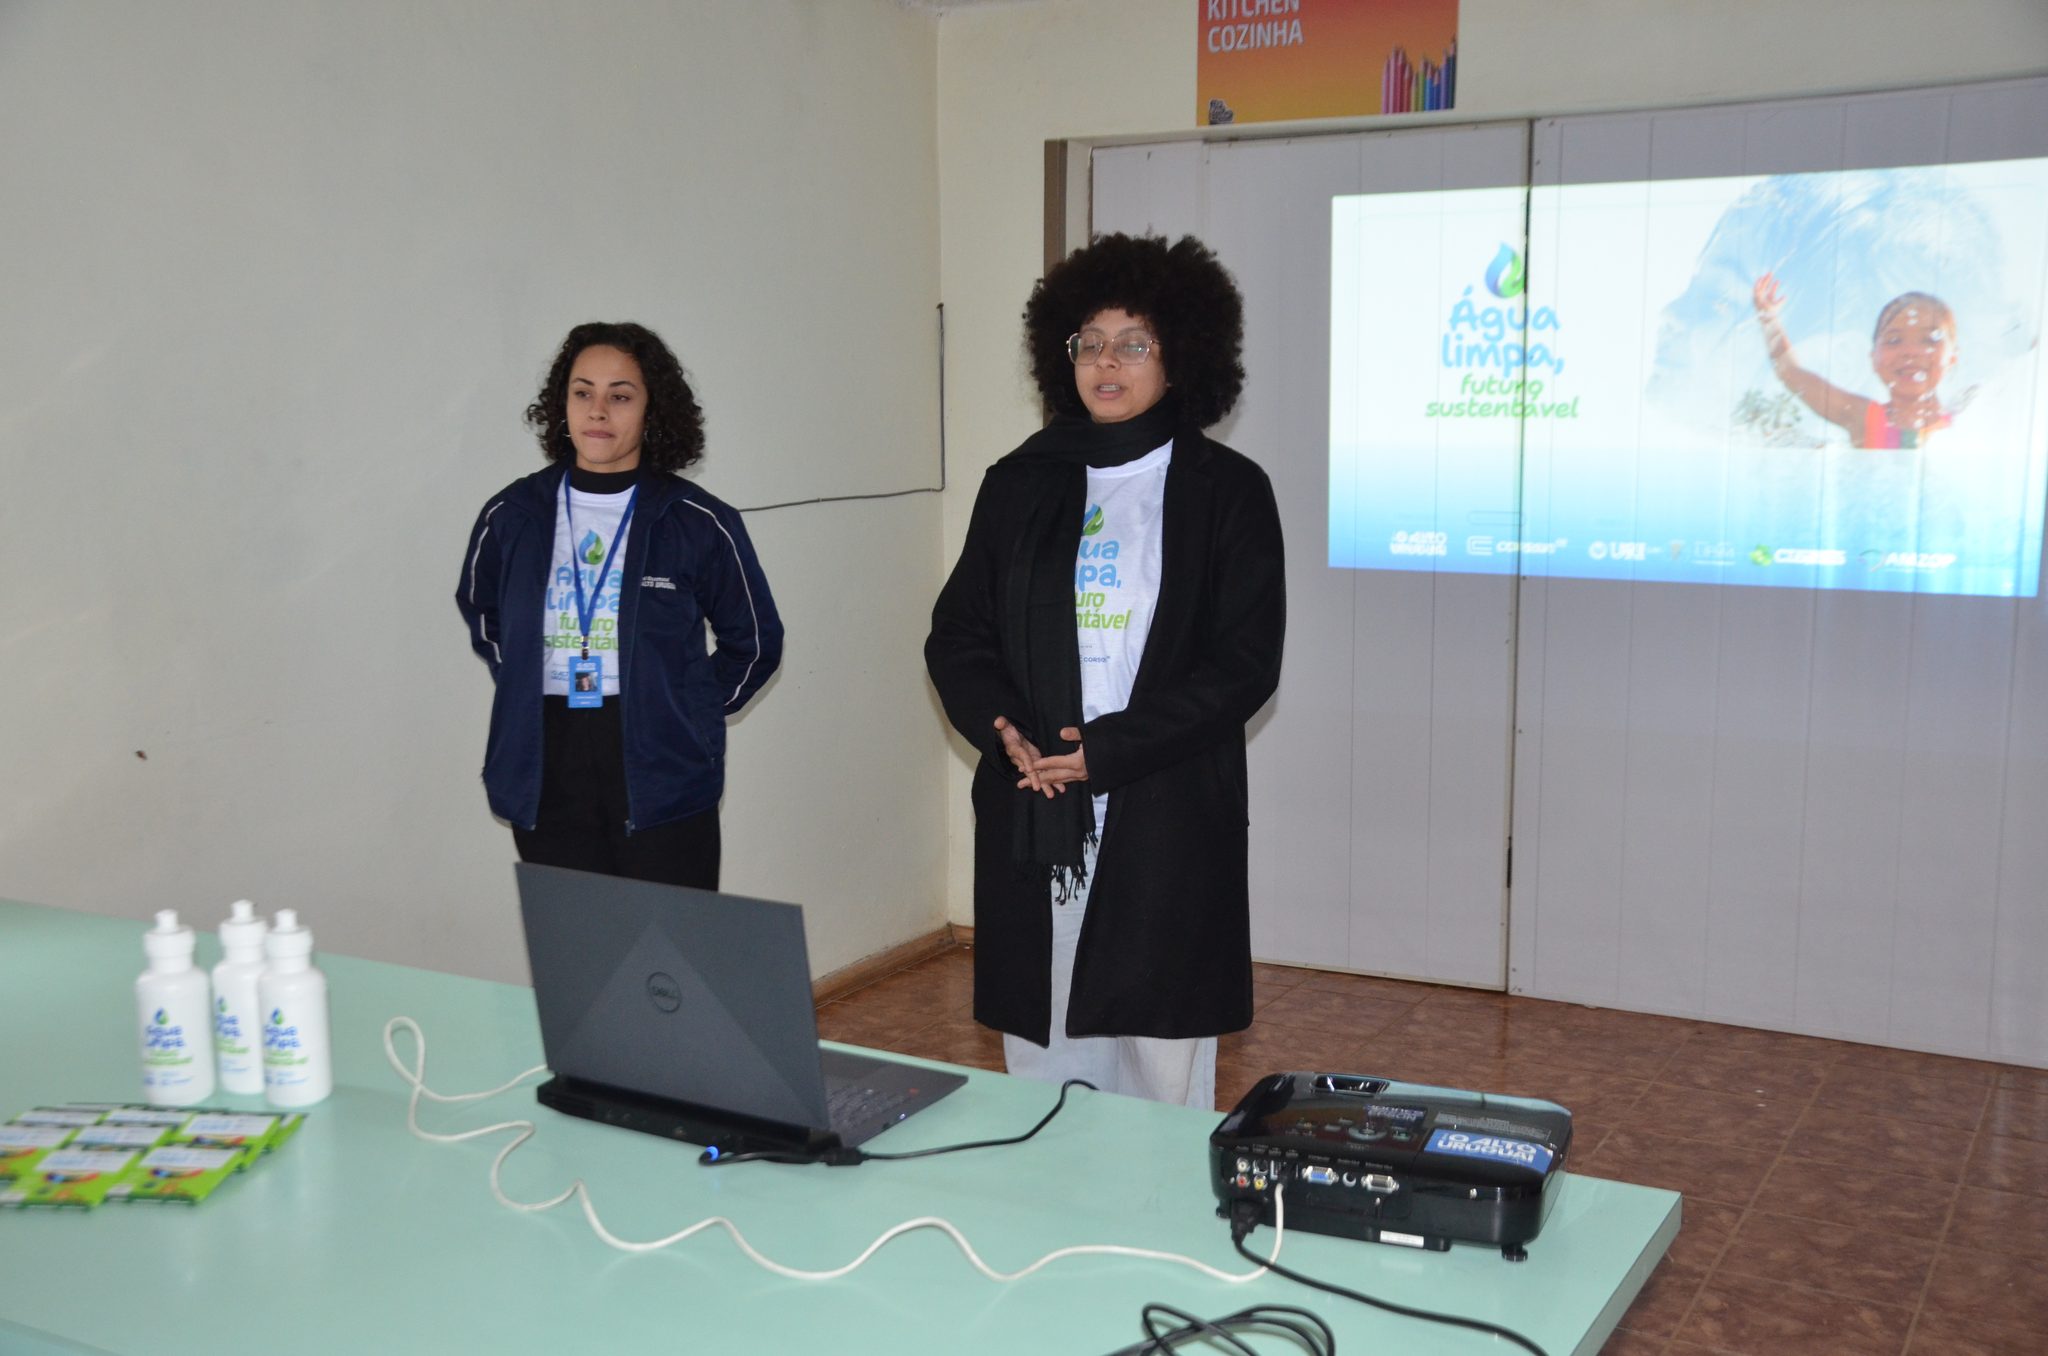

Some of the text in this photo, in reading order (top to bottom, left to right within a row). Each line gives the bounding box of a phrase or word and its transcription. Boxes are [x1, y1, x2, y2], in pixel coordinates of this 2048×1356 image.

[1208, 18, 1304, 54] COZINHA
[1449, 285, 1561, 342] Água
[1441, 333, 1566, 379] limpa,
[1460, 372, 1544, 398] futuro
[1425, 395, 1580, 418] sustentável
[1079, 539, 1120, 560] ua
[1077, 563, 1122, 592] pa,
[1075, 592, 1105, 608] uro
[1076, 608, 1132, 630] ntável
[1437, 1139, 1535, 1163] URUGUAI
[1470, 1138, 1537, 1155] ALTO
